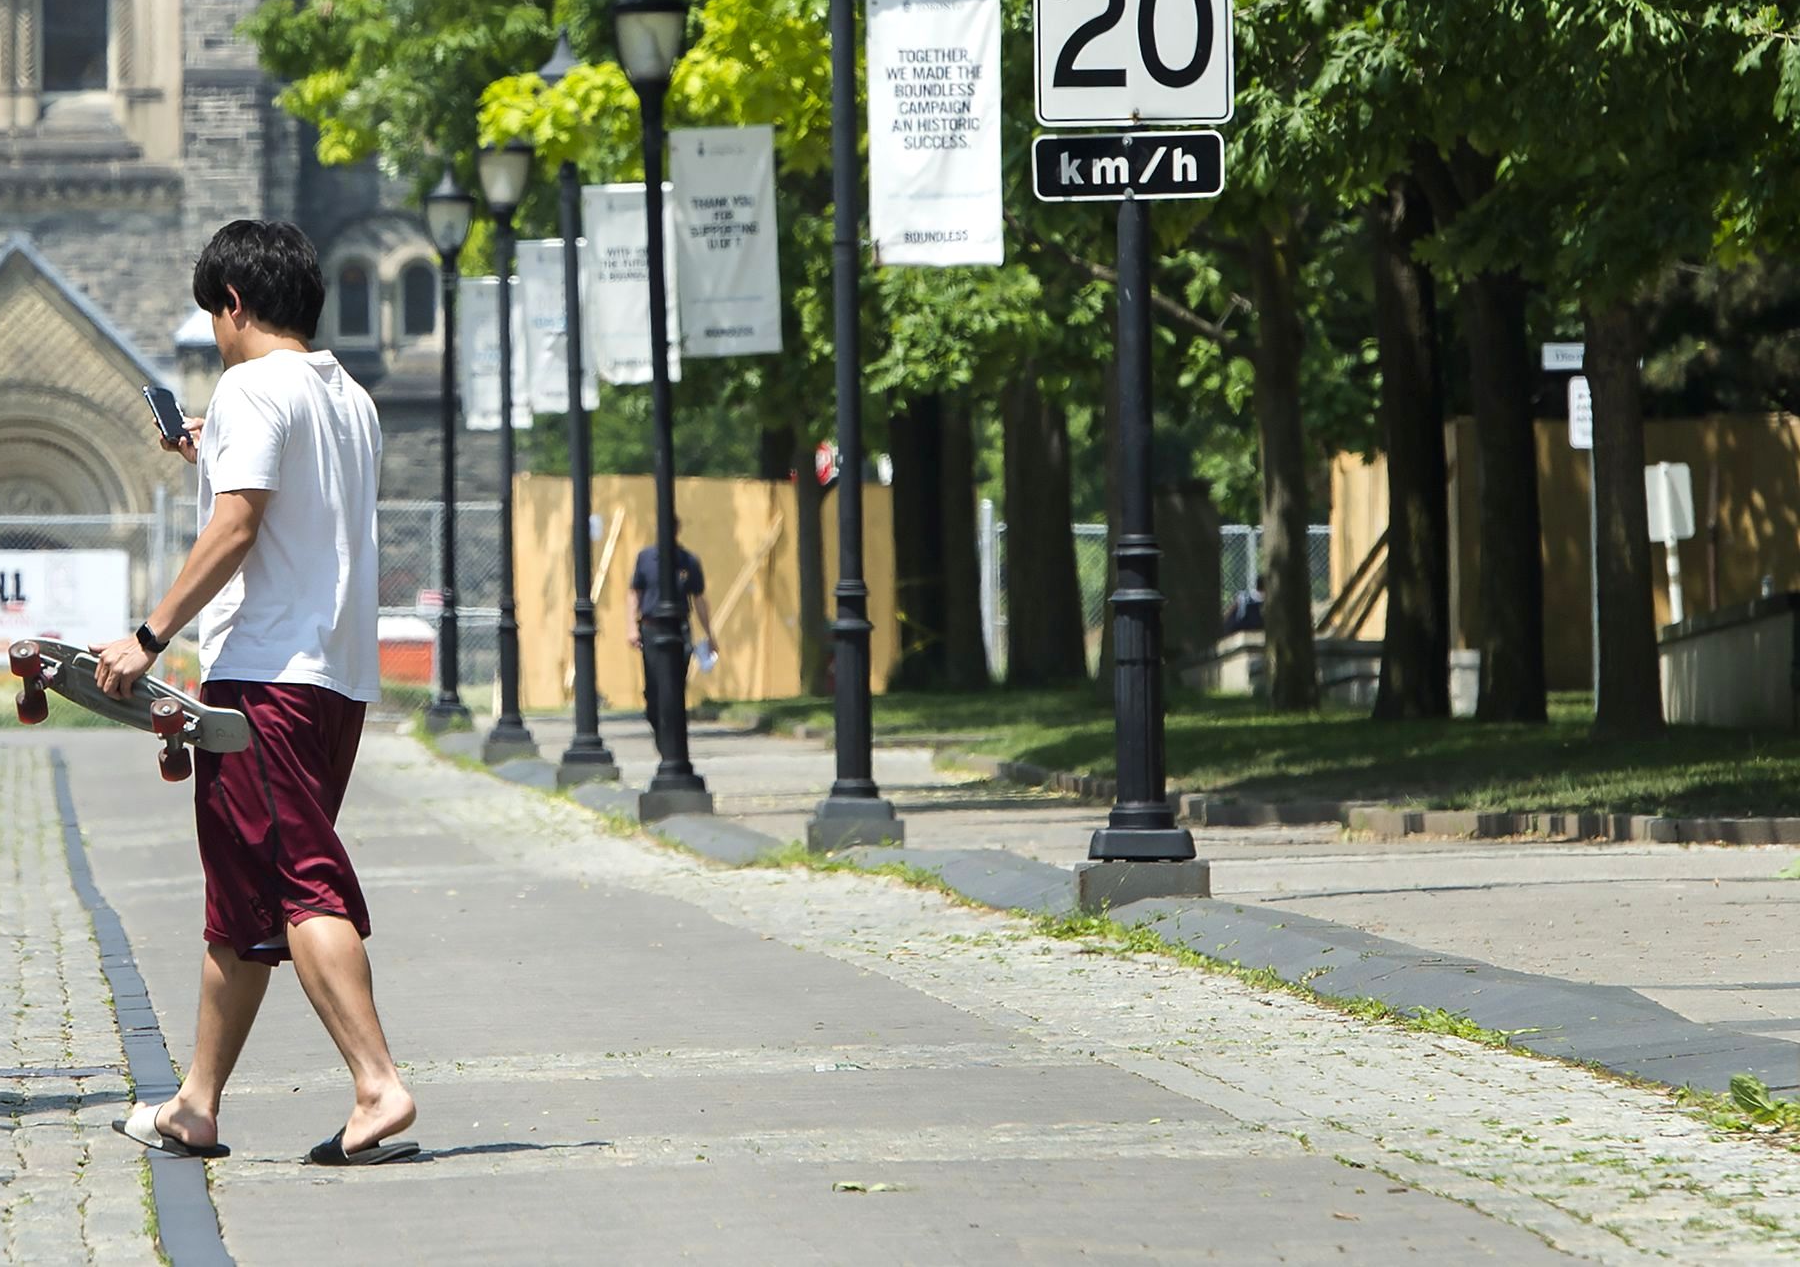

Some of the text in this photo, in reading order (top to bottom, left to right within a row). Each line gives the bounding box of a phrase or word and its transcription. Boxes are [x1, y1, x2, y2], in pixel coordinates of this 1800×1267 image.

[886, 64, 982, 81] WE MADE THE
[894, 82, 976, 98] BOUNDLESS
[899, 99, 972, 115] CAMPAIGN
[891, 117, 981, 133] AN HISTORIC
[1059, 145, 1198, 186] km/h
[903, 229, 969, 245] BOUNDLESS
